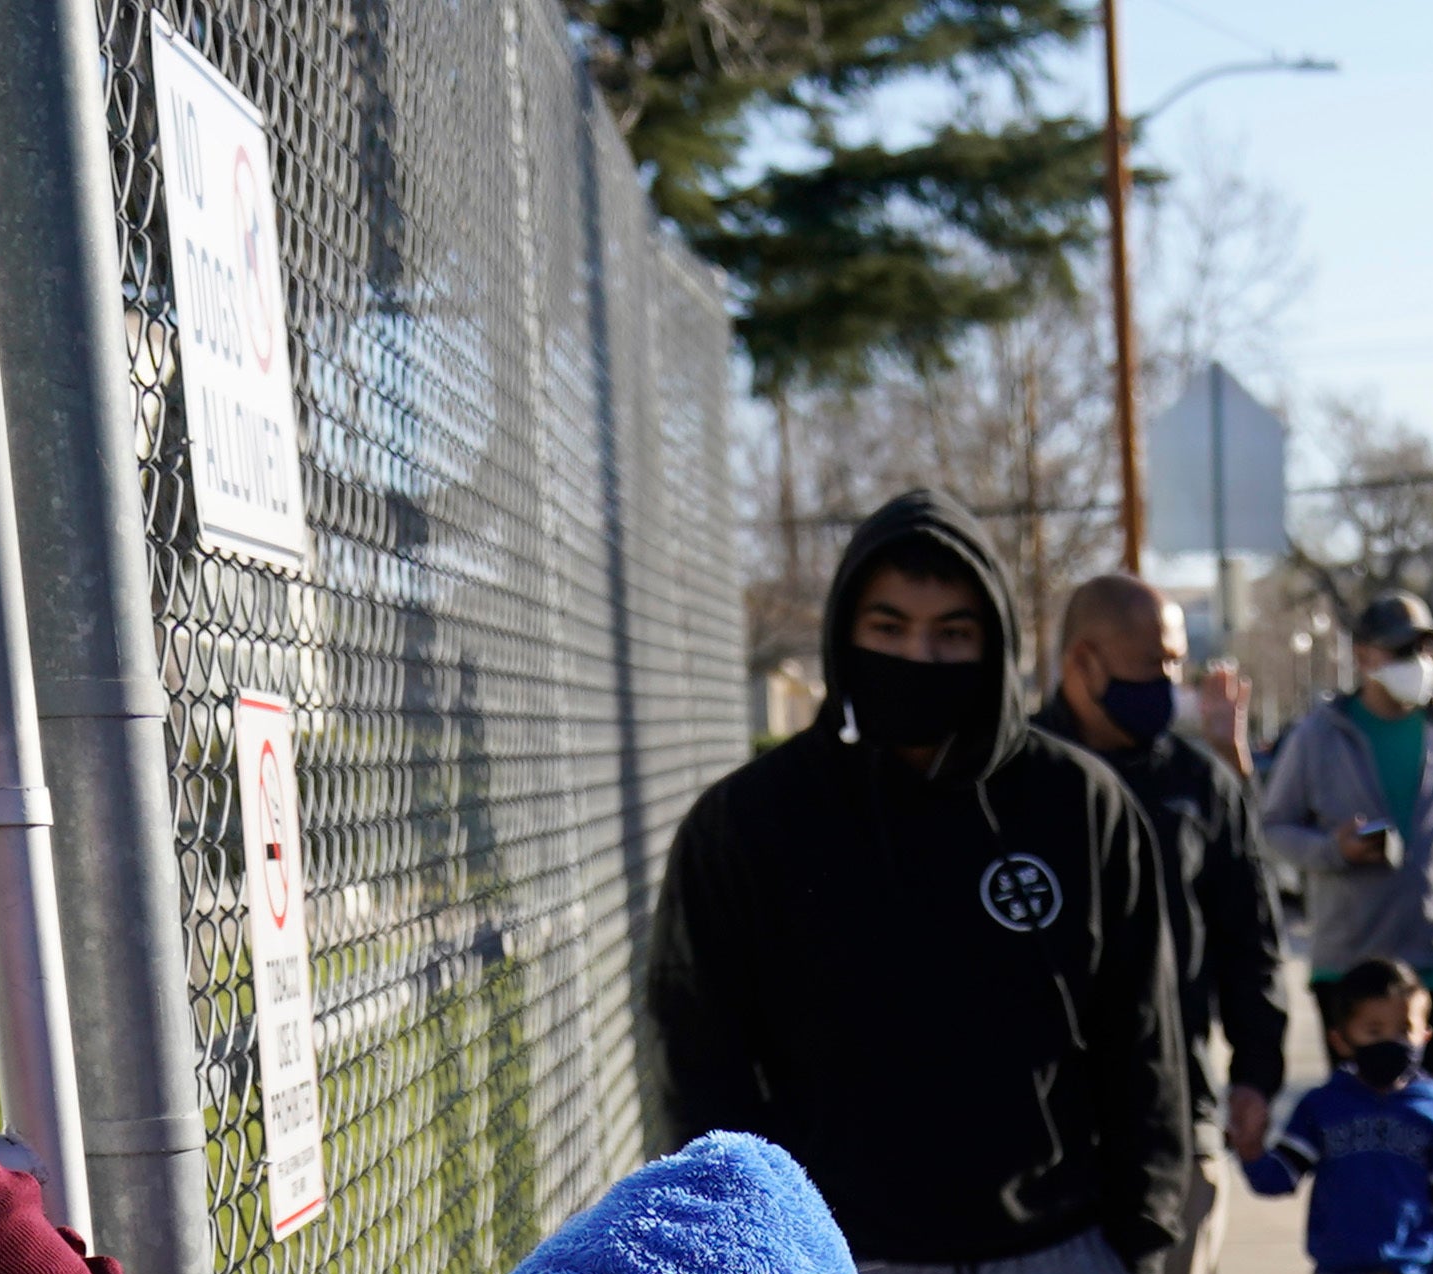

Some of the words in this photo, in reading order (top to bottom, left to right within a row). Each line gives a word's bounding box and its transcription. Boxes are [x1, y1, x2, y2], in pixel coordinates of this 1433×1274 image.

[170, 85, 204, 211] NO
[185, 237, 244, 368] DOGS
[202, 386, 289, 514] ALLOWED
